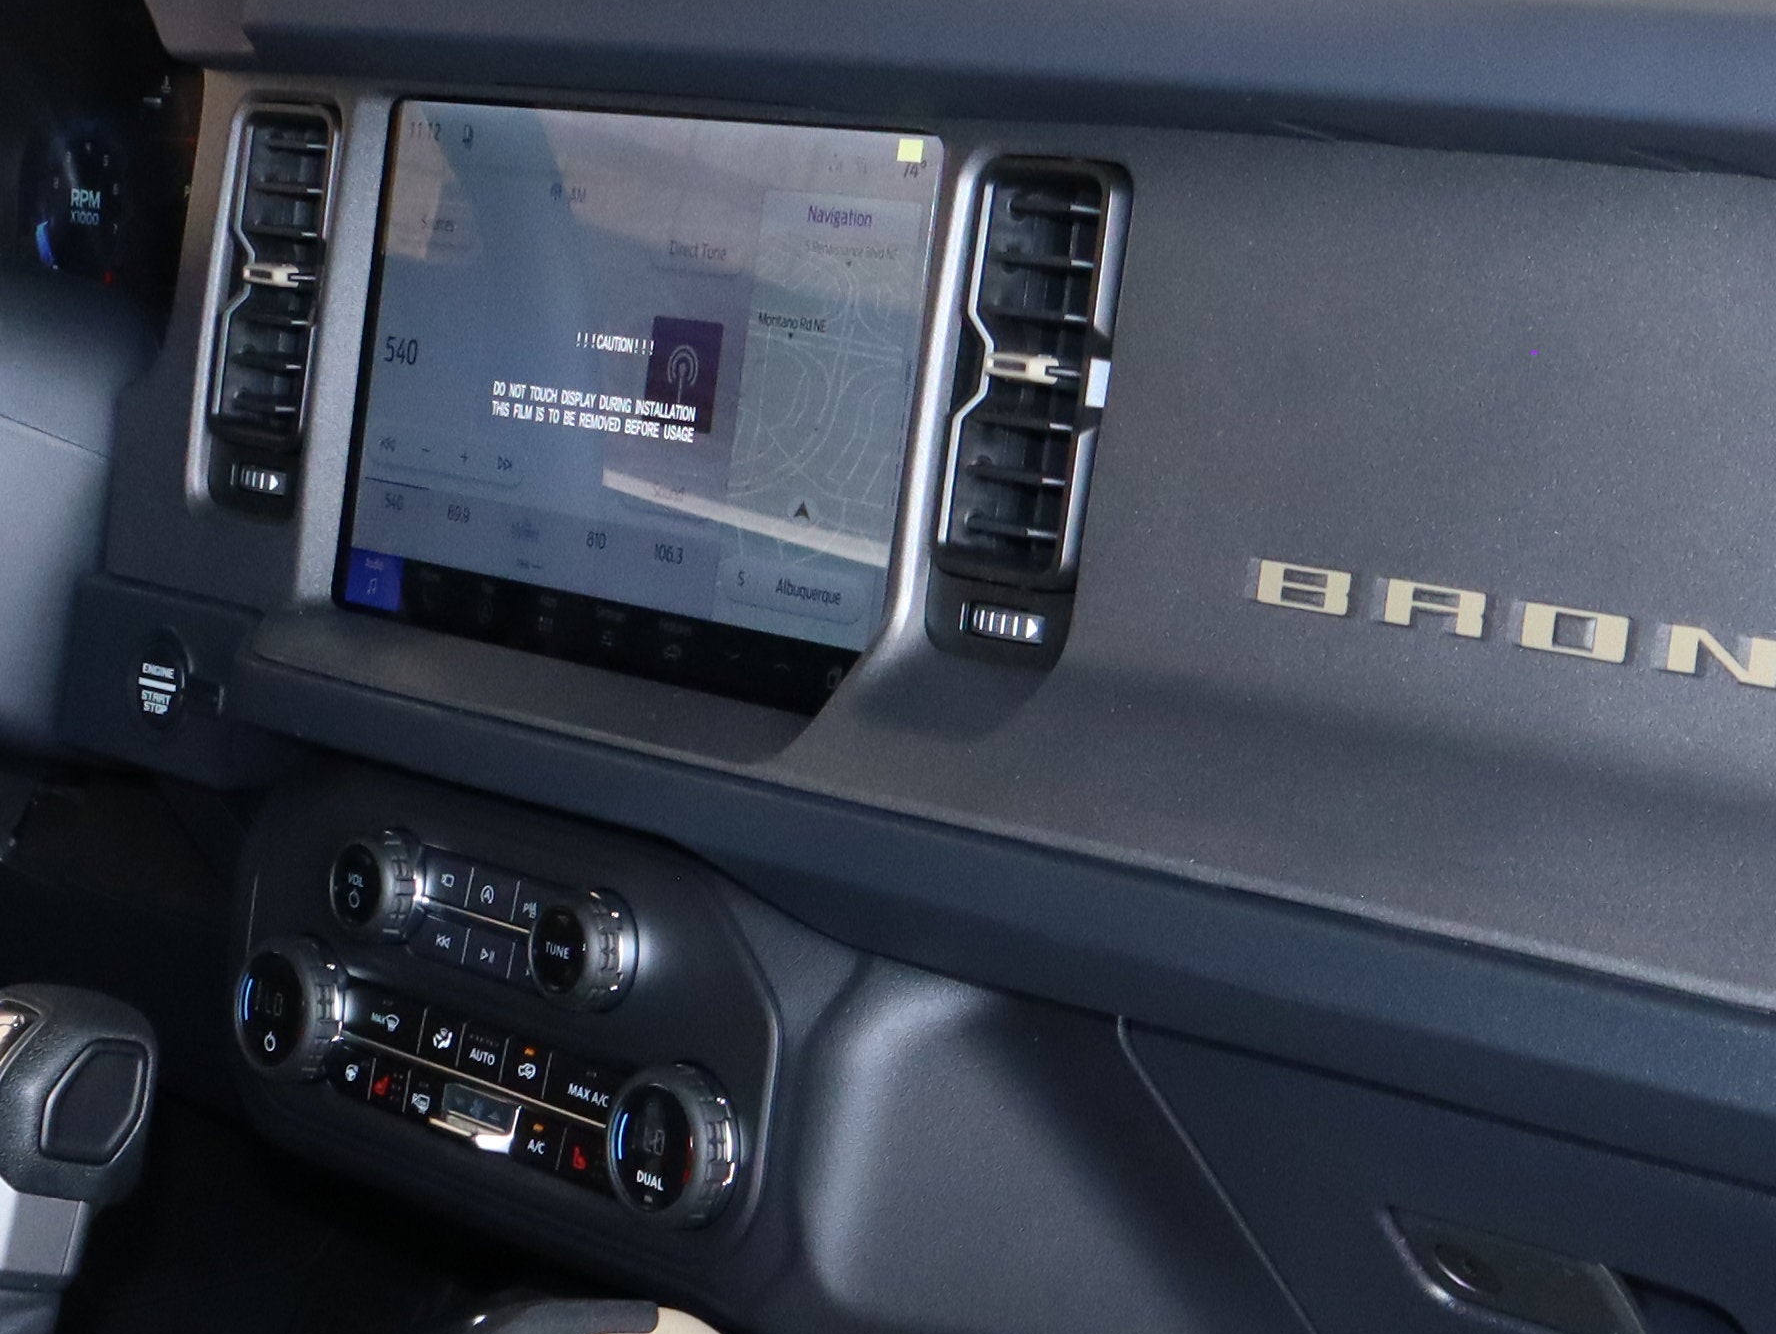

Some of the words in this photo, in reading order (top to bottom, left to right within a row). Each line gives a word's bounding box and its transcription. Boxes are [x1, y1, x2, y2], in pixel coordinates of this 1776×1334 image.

[70, 188, 101, 209] RPM
[808, 205, 873, 228] Navigation
[384, 335, 418, 365] 540
[493, 380, 505, 396] DO
[508, 382, 526, 399] NOT
[530, 385, 557, 403] TOUCH
[561, 389, 597, 408] DISPLAY
[599, 394, 631, 414] DURING
[635, 398, 697, 422] INSTALLATION
[492, 400, 510, 417] THIS
[513, 403, 533, 420] FILM
[535, 407, 545, 422] IS
[548, 407, 560, 424] TO
[563, 410, 576, 426] BE
[578, 412, 621, 433] REMOVED
[624, 419, 660, 439] BEFORE
[664, 426, 695, 443] USAGE
[654, 543, 683, 564] 106.3
[776, 578, 842, 606] Albuquerque
[141, 689, 172, 705] START
[143, 700, 168, 715] STOP
[348, 873, 364, 888] VOL
[545, 941, 570, 960] TUNE
[469, 1047, 496, 1066] AUTO
[567, 1083, 590, 1101] MAX
[591, 1091, 610, 1108] A/C
[527, 1138, 546, 1155] A/C
[636, 1170, 664, 1191] DUAL
